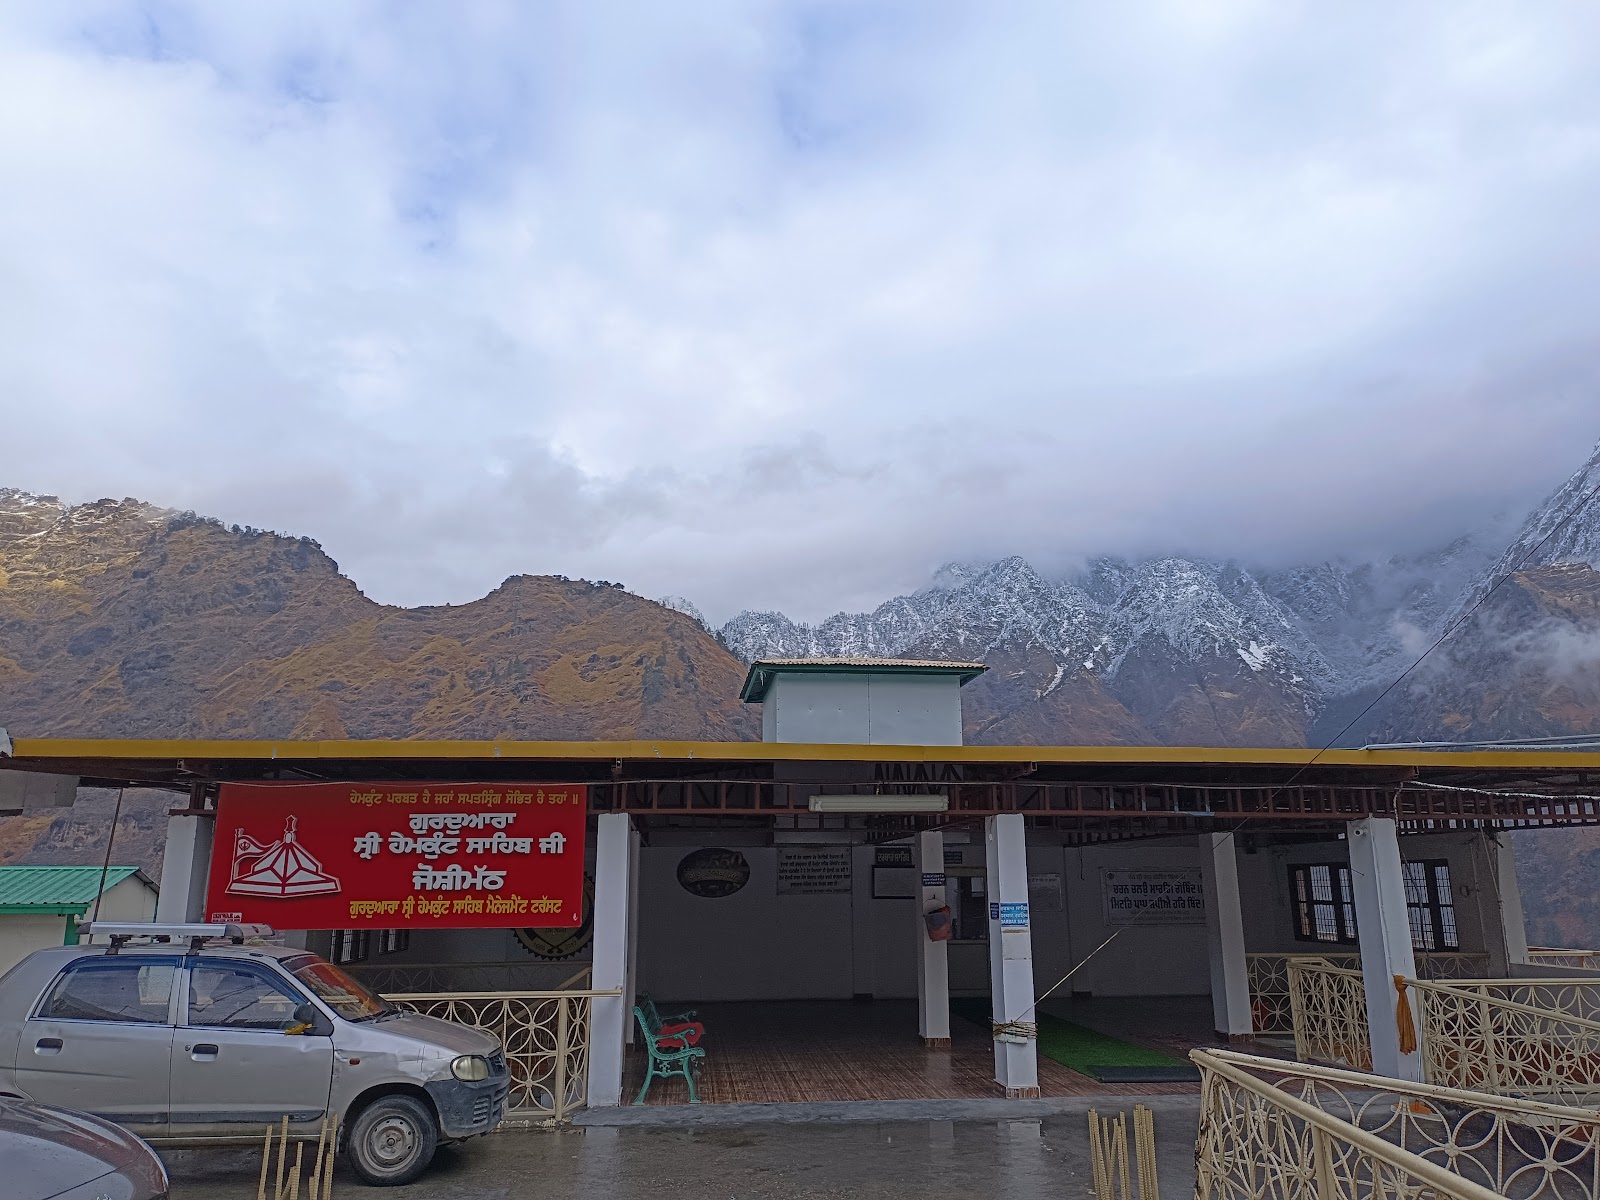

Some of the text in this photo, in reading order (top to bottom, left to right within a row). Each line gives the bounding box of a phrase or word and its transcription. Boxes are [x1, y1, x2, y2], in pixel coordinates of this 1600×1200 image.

[350, 789, 383, 807] ਹੇਮਕੁੰਟ
[387, 792, 418, 804] ਪਰਬਤ
[422, 789, 432, 804] ਹੈ
[435, 790, 454, 804] ਜਹਾਂ
[506, 789, 534, 804] ਸੋਭਿਤ
[537, 789, 546, 804] ਹੈ
[549, 790, 568, 804] ਤਹਾਂ
[409, 812, 517, 834] ਗੁਰਦੁਆਰਾ
[353, 831, 567, 859] ਸ੍ਰੀ ਹੇਮਕੁੰਟ ਸਾਹਿਬ ਜੀ
[412, 863, 507, 890] ਜੋਸ਼ੀਮੱਠ
[1113, 884, 1129, 894] ਚਰਨ
[1131, 881, 1148, 896] ਚਲਉ
[1175, 881, 1196, 894] ਗੋਬਿੰਦ
[350, 894, 563, 918] ਗੁਰਦੁਆਰਾ ਸ੍ਰੀ ਹੇਮਕੁੰਟ ਸਾਹਿਬ ਮੈਨੇਜਮੈਂਟ ਟਰੱਸਟ
[1111, 897, 1132, 909] ਮਿਟਹਿ
[1133, 900, 1148, 909] ਪਾਪ
[1173, 897, 1186, 909] ਹਰਿ
